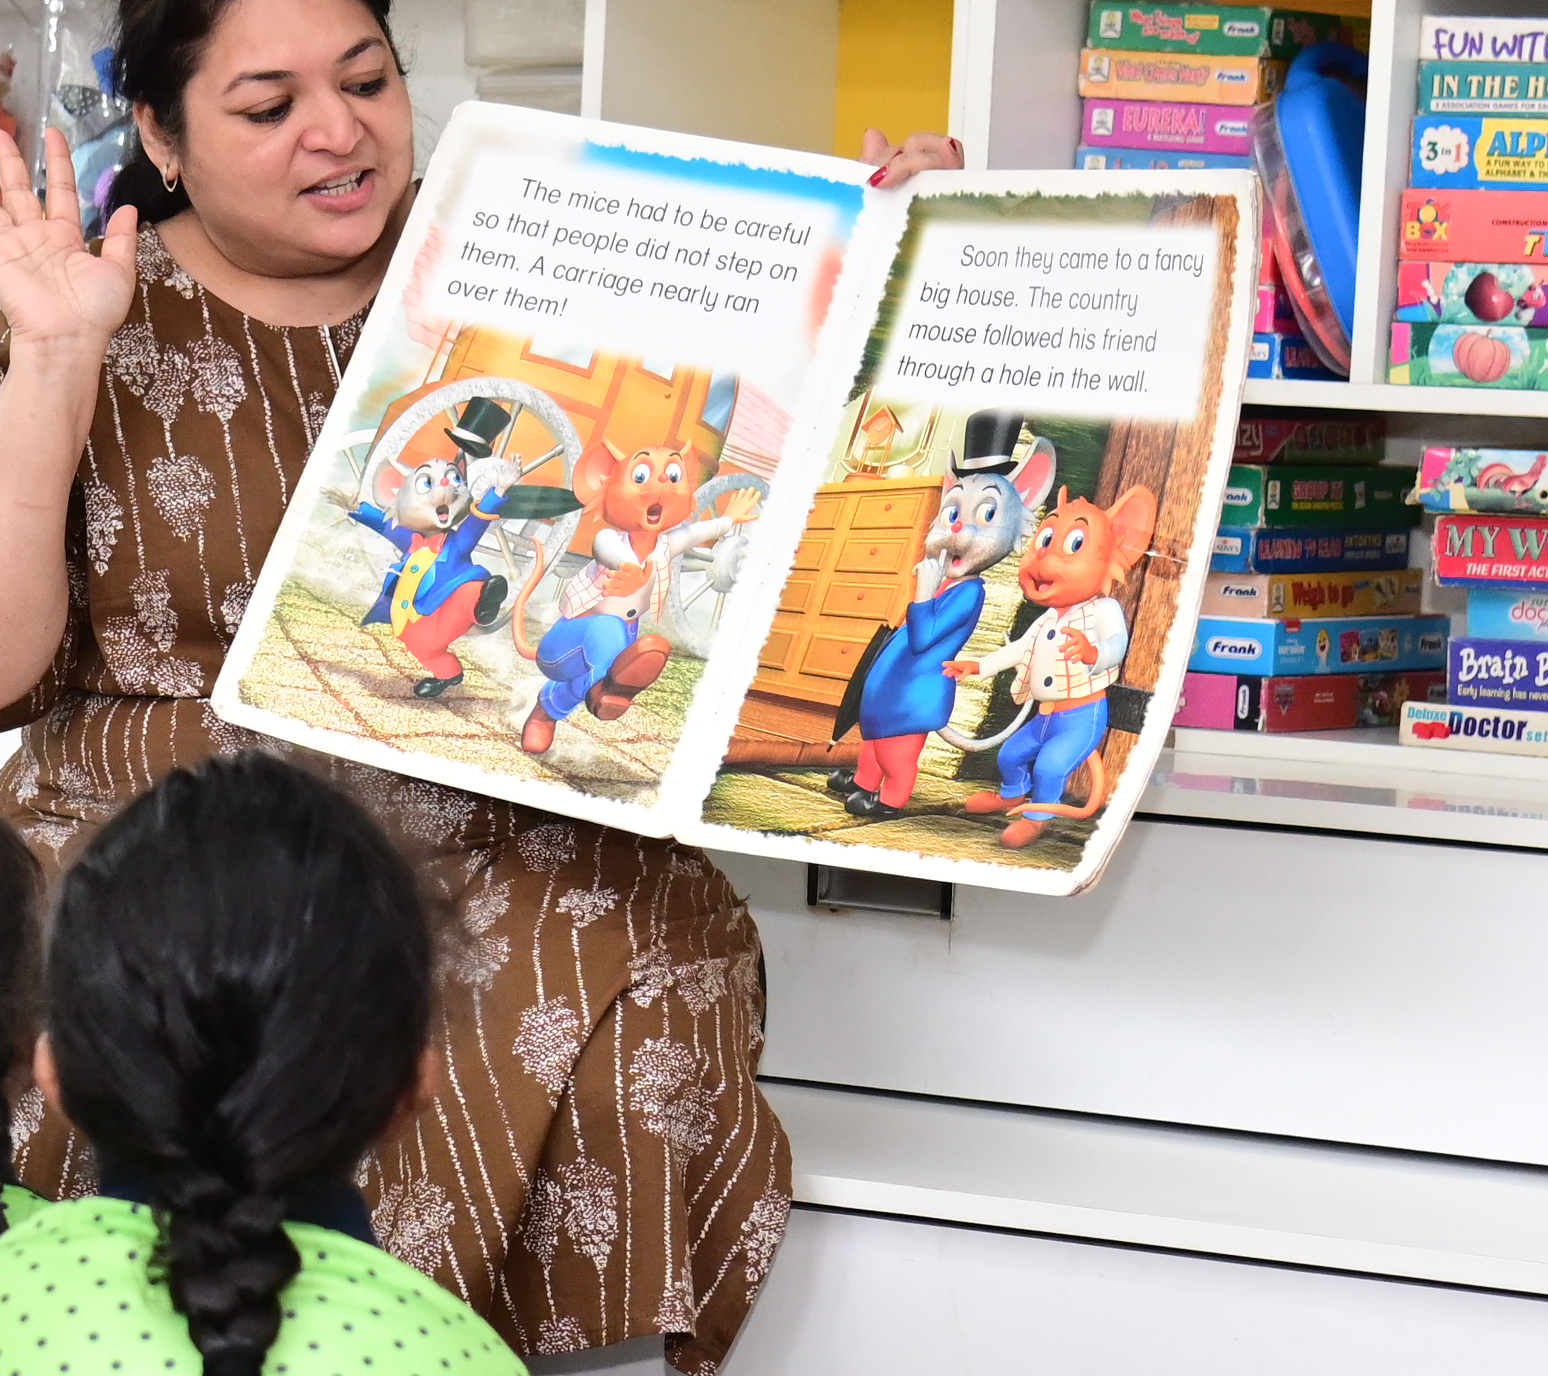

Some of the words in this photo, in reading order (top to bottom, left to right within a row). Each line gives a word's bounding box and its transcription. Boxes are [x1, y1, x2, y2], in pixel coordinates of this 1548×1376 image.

[1433, 28, 1486, 61] FUN
[1431, 75, 1460, 98] IN
[1467, 76, 1519, 99] THE
[1122, 106, 1207, 134] EUREKA!
[521, 178, 561, 203] The
[568, 191, 620, 215] mice
[627, 198, 669, 222] had
[673, 206, 693, 226] to
[700, 209, 727, 232] be
[734, 217, 811, 246] careful
[473, 212, 499, 229] so
[507, 213, 550, 239] that
[552, 225, 628, 254] people
[636, 238, 669, 260] did
[675, 245, 710, 267] not
[715, 252, 762, 280] step
[770, 265, 798, 282] on
[961, 245, 1008, 268] Soon
[1015, 246, 1054, 274] they
[1059, 250, 1108, 269] came
[1115, 248, 1132, 270] to
[1138, 252, 1149, 270] a
[1155, 248, 1204, 277] fancy
[460, 241, 520, 272] them.
[529, 256, 545, 275] A
[552, 263, 643, 297] carriage
[650, 281, 718, 312] nearly
[725, 295, 760, 314] ran
[447, 280, 498, 303] over
[504, 288, 568, 317] them!
[920, 282, 950, 309] big
[956, 284, 1019, 307] house.
[1028, 286, 1062, 309] The
[1069, 288, 1138, 317] country
[908, 323, 976, 343] mouse
[983, 324, 1064, 348] followed
[1069, 327, 1096, 350] his
[1102, 329, 1157, 352] friend
[897, 355, 975, 386] through
[981, 366, 994, 383] a
[999, 363, 1041, 386] hole
[1047, 367, 1064, 388] in
[1071, 368, 1100, 389] the
[1108, 370, 1148, 393] wall.
[1444, 524, 1500, 558] MY
[1465, 563, 1489, 576] THE
[1491, 564, 1526, 578] FIRST
[1222, 585, 1257, 597] Frank
[1212, 641, 1256, 655] Frank
[1459, 647, 1529, 683] Brain
[1407, 706, 1447, 721] Deluxe
[1448, 711, 1528, 741] Doctor
[1527, 729, 1548, 743] set
